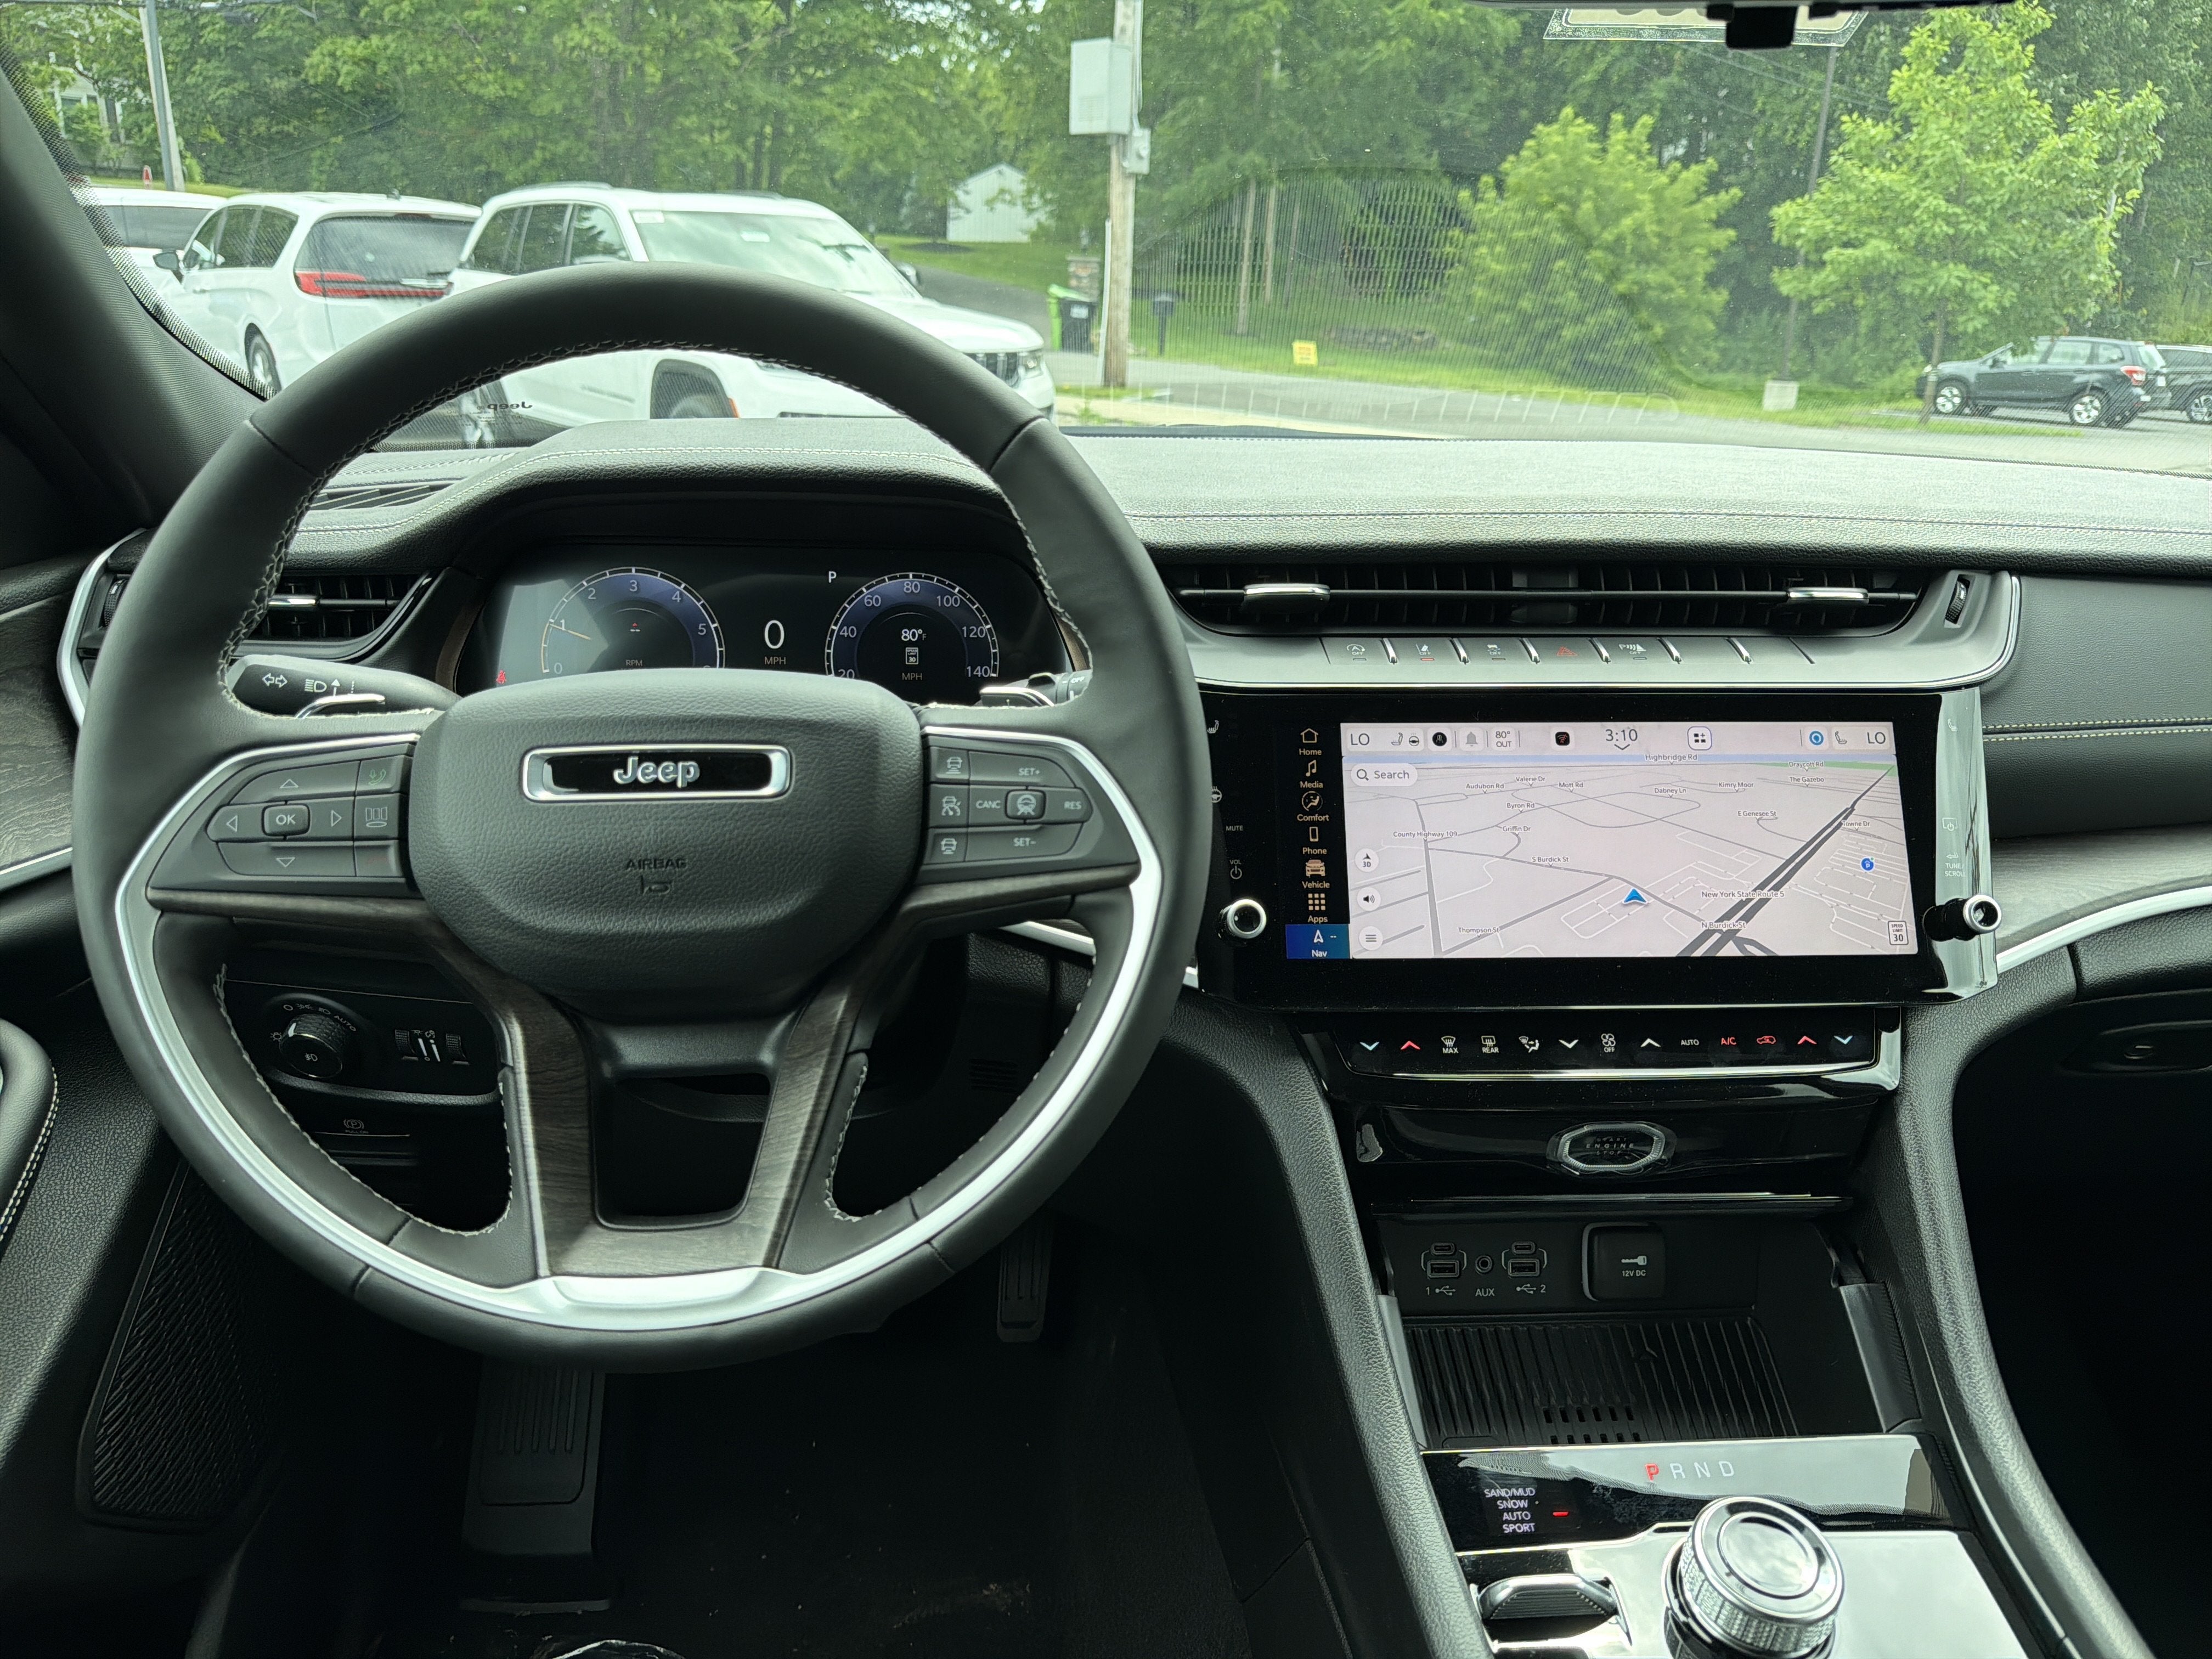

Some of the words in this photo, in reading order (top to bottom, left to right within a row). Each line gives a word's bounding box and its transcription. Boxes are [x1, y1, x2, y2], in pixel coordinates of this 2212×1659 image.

[828, 571, 837, 583] P
[629, 580, 637, 592] 3
[903, 582, 921, 593] 80
[588, 589, 596, 600] 2
[672, 591, 681, 602] 4
[864, 595, 881, 607] 60
[936, 595, 961, 607] 100
[560, 619, 565, 630] 1
[698, 623, 707, 635] 5
[764, 620, 785, 649] 0
[839, 626, 857, 638] 40
[962, 626, 986, 638] 120
[764, 656, 786, 665] MPH
[554, 663, 563, 674] 0
[838, 669, 855, 679] 20
[966, 665, 990, 677] 140
[1070, 676, 1085, 684] OFF
[1350, 733, 1370, 746] LO
[1495, 730, 1511, 740] 80°
[1605, 729, 1638, 742] 3:10
[1867, 731, 1886, 744] LO
[1645, 753, 1688, 762] Highbridge
[1689, 753, 1697, 762] Rd
[613, 755, 700, 788] Jeep
[1374, 769, 1410, 780] Search
[975, 800, 1001, 809] CANC
[1064, 801, 1082, 810] RES
[275, 814, 296, 824] OK
[1393, 831, 1415, 839] County
[1416, 831, 1444, 839] Highway
[1446, 831, 1458, 839] 109
[625, 858, 687, 870] AIRBAG
[1307, 915, 1328, 924] Apps
[1893, 934, 1904, 942] 30
[334, 1014, 357, 1031] AUTO
[1720, 1036, 1737, 1046] A/C
[1426, 1286, 1430, 1296] 1
[1475, 1288, 1496, 1297] AUX
[1540, 1284, 1546, 1294] 2
[1646, 1463, 1660, 1480] P
[1669, 1462, 1686, 1480] R
[1694, 1461, 1711, 1479] N
[1718, 1460, 1735, 1477] D
[1484, 1487, 1536, 1498] SAND/MUD
[1497, 1500, 1529, 1510] SNOW
[1502, 1511, 1531, 1521] AUTO
[1502, 1522, 1536, 1533] SPORT
